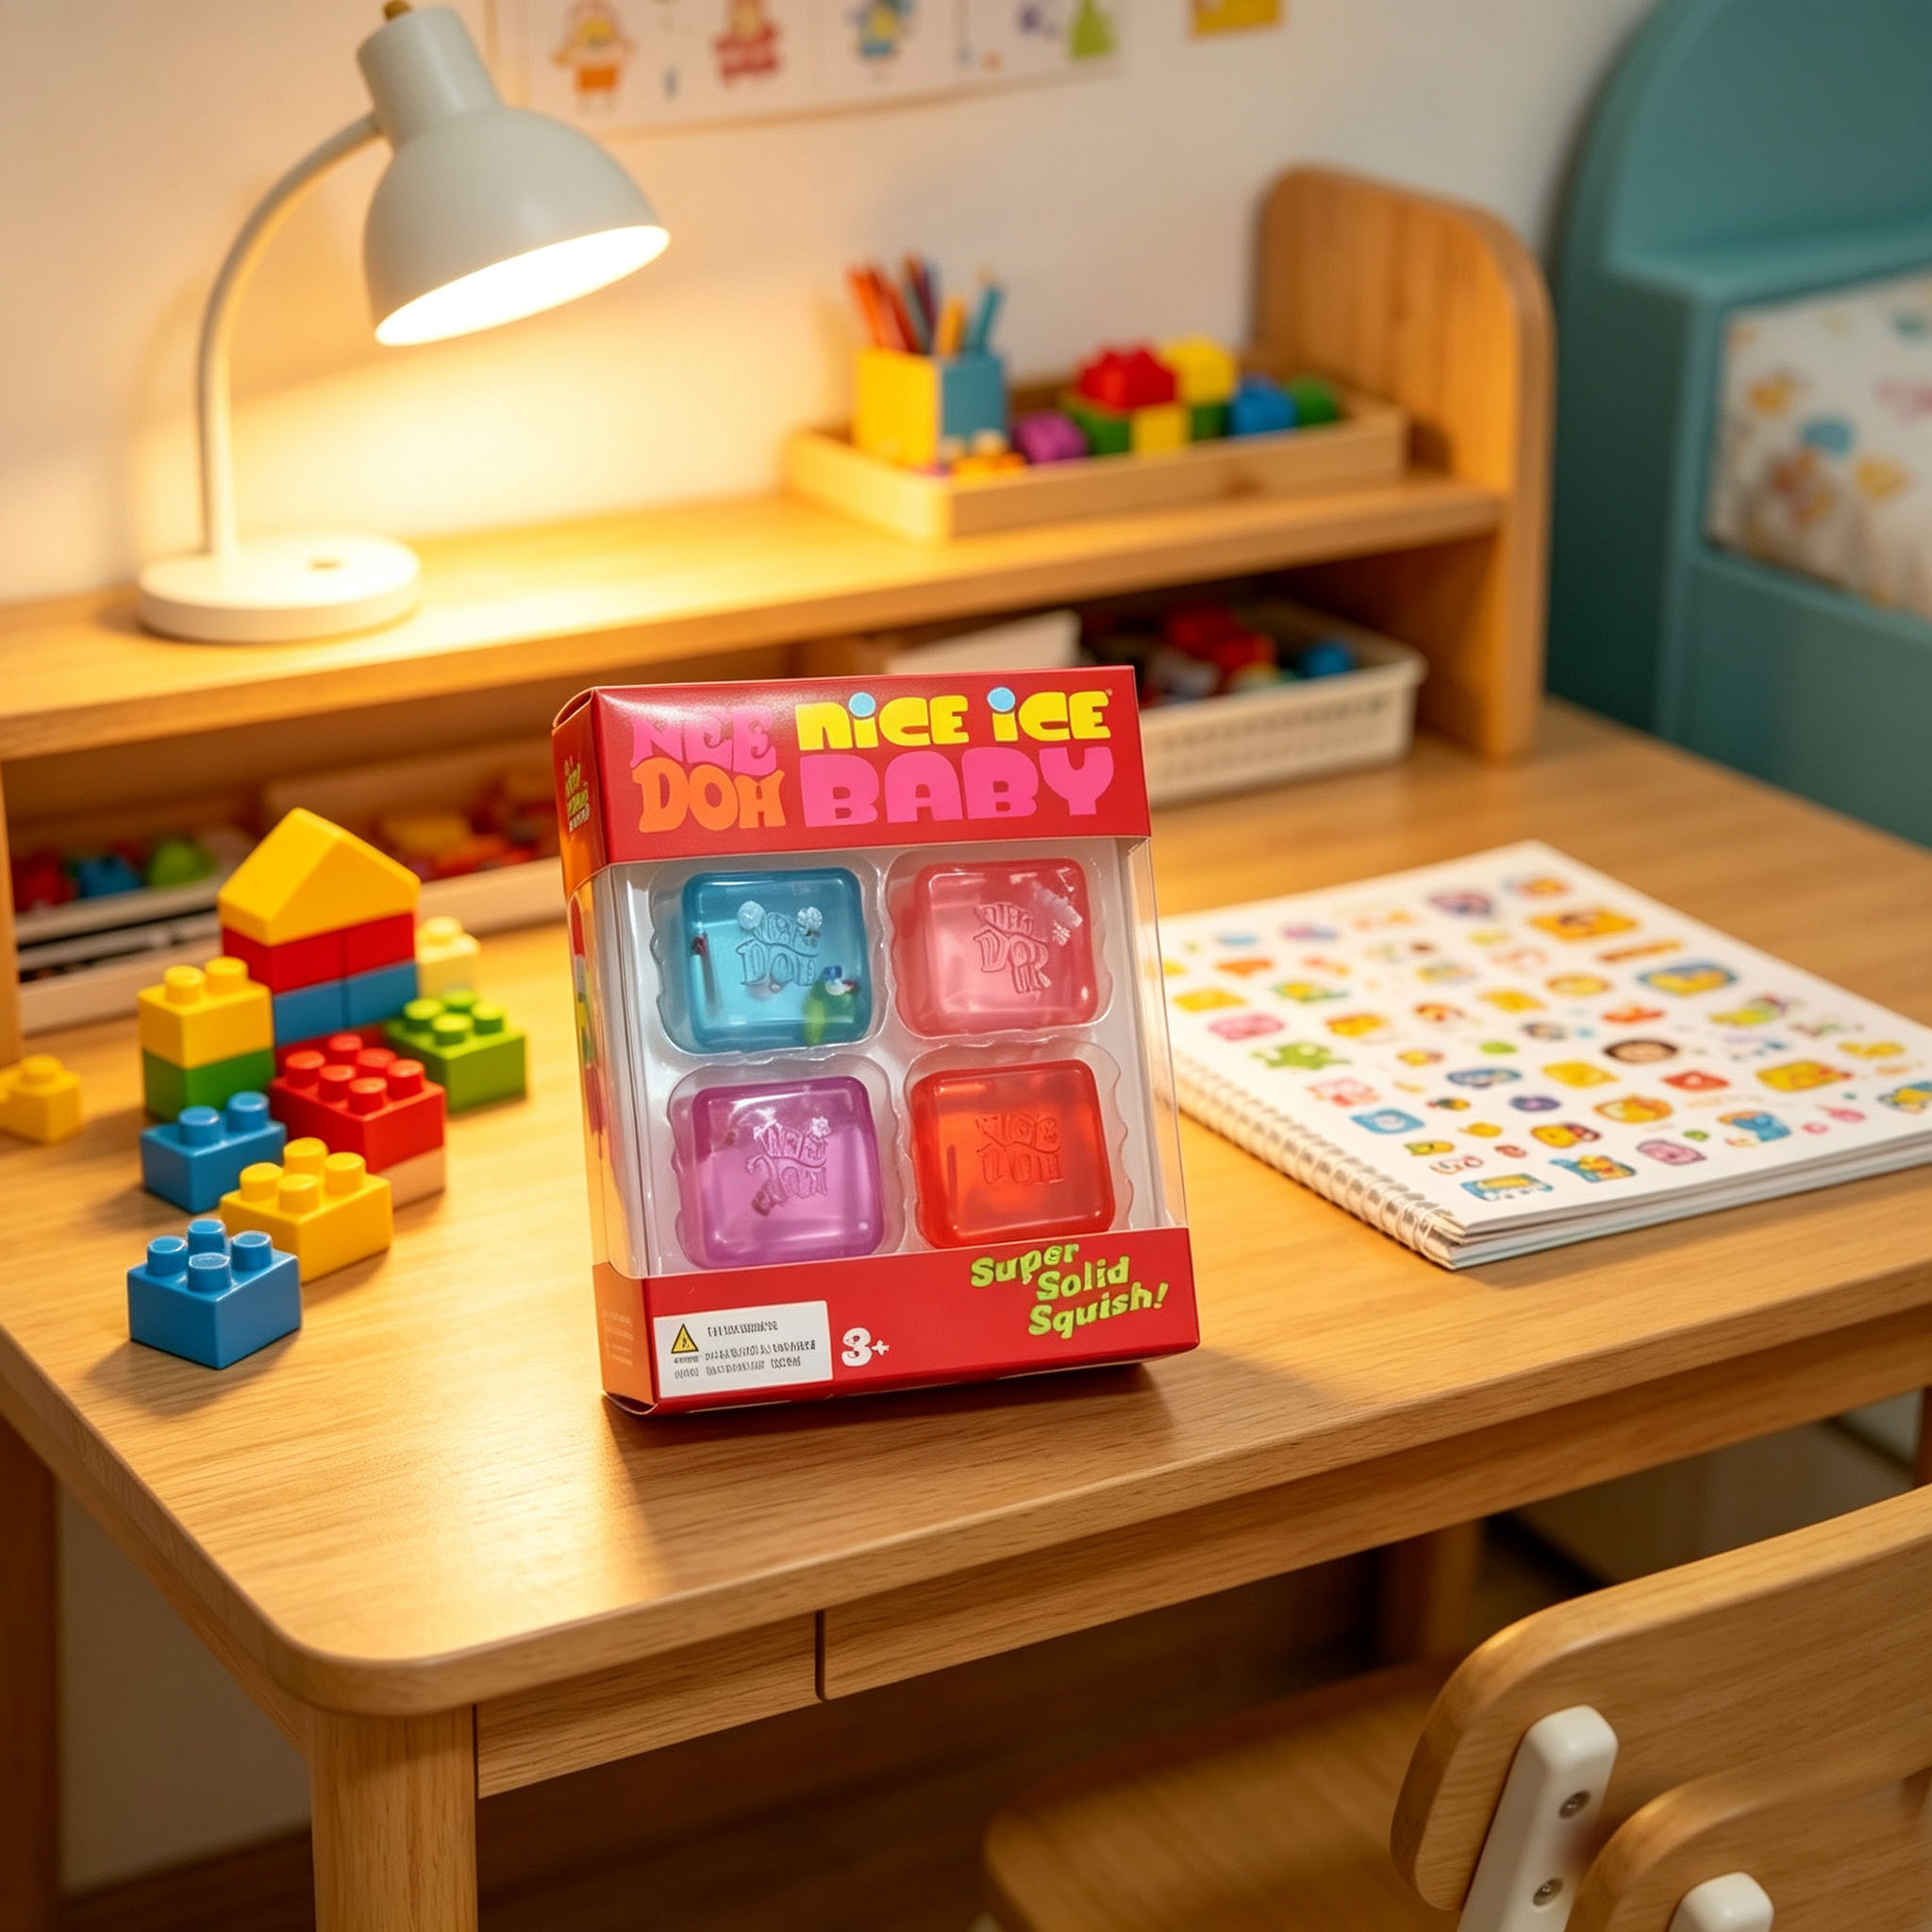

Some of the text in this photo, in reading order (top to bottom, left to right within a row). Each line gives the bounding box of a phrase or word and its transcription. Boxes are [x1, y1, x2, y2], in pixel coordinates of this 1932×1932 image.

[632, 757, 787, 833] DOH
[800, 746, 1114, 827] BABY
[971, 1243, 1079, 1287] Super
[1037, 1256, 1130, 1301] Solid
[1028, 1282, 1169, 1340] Squish!
[841, 1327, 890, 1367] 3+
